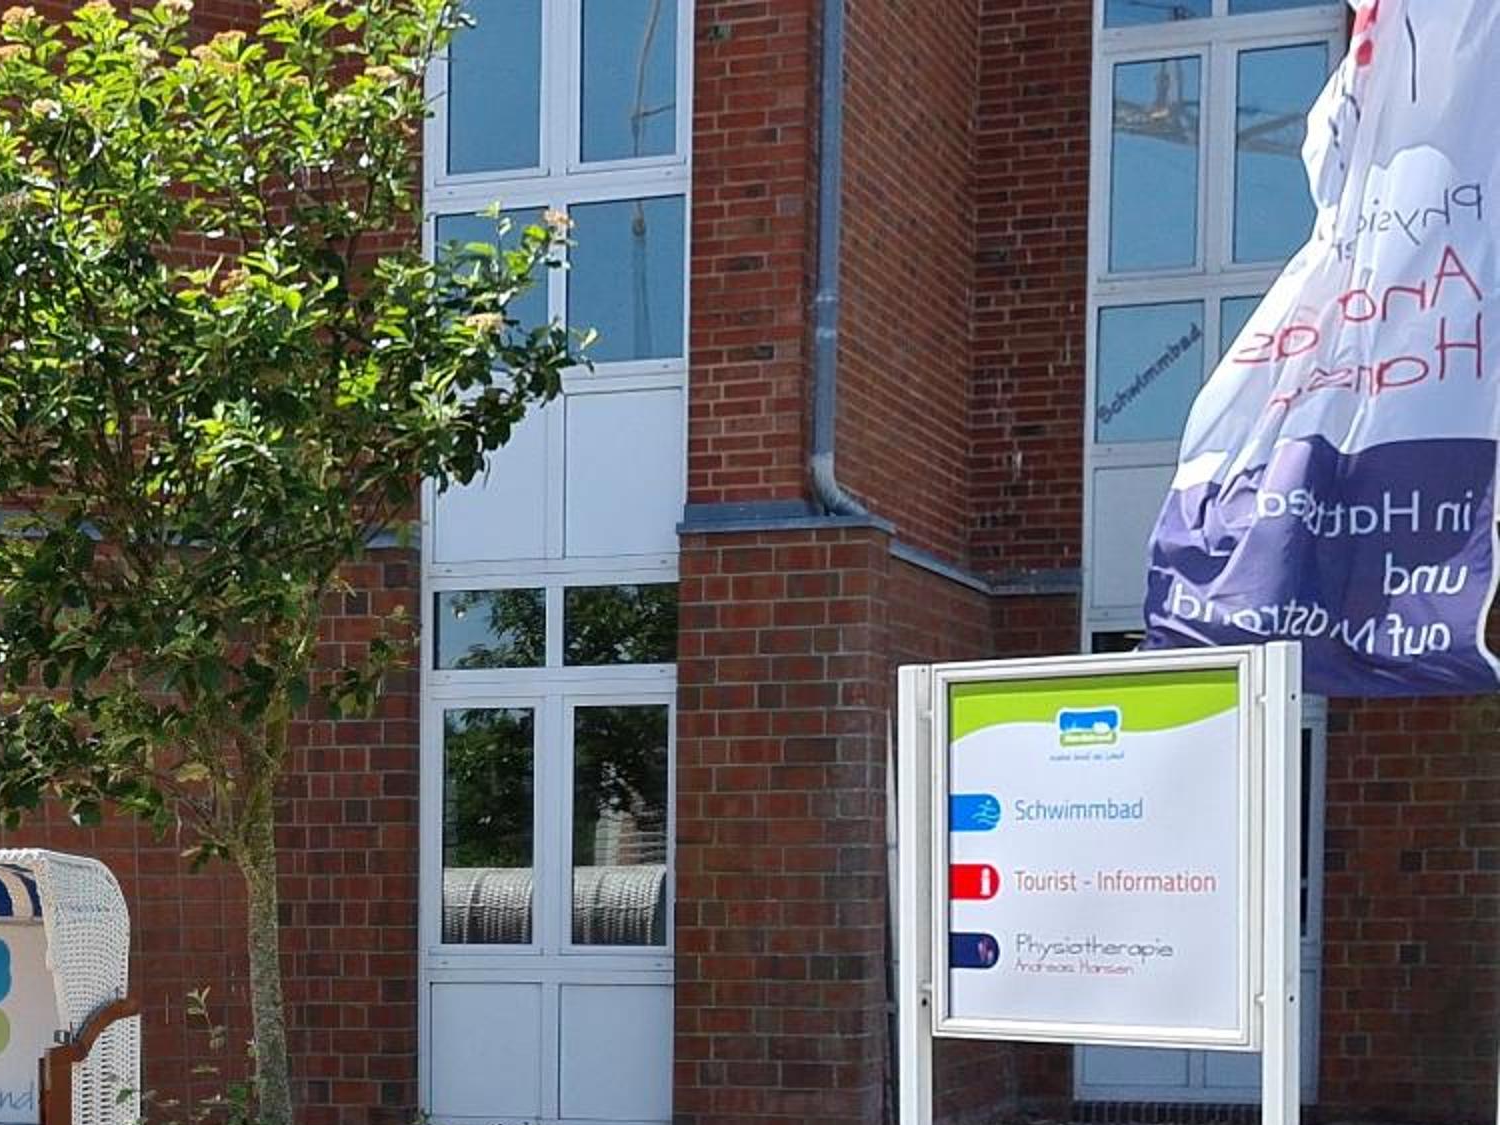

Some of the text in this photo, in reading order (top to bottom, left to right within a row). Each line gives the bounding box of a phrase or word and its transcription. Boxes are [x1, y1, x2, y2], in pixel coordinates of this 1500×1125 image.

[1097, 321, 1204, 424] Schwimmbad
[1014, 798, 1144, 821] Schwimmbad
[1014, 870, 1077, 892] Tourist
[1097, 869, 1217, 893] Information
[1015, 932, 1175, 964] Physiotherapie
